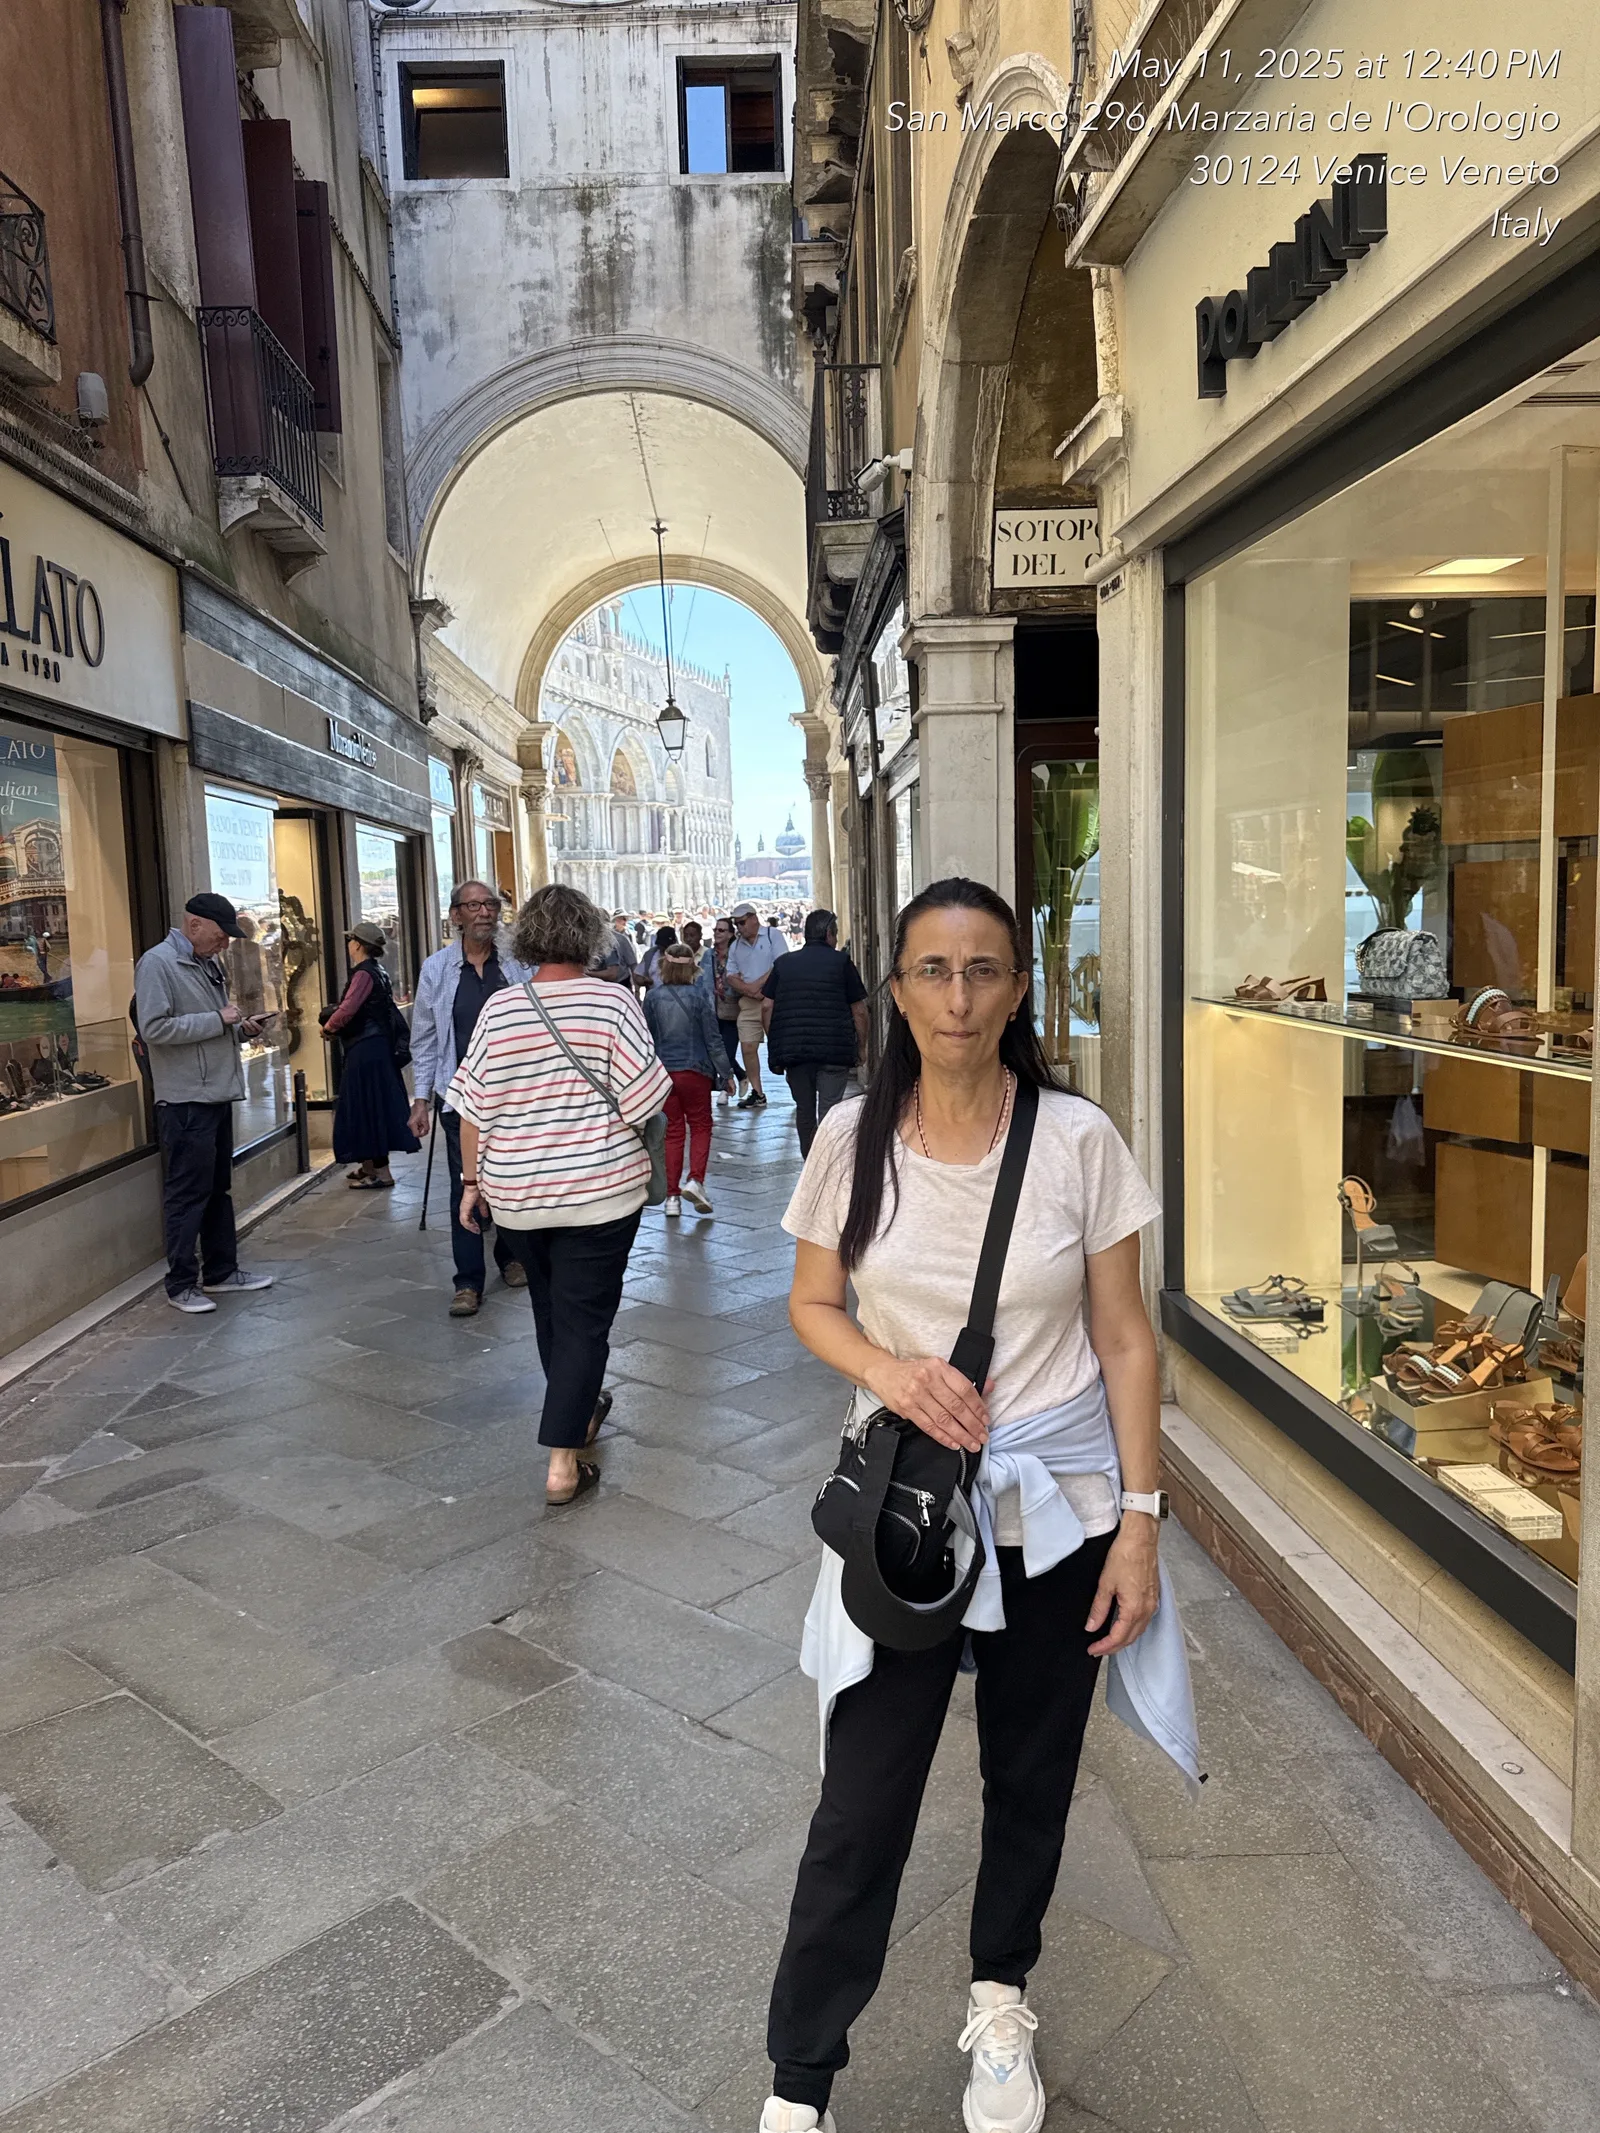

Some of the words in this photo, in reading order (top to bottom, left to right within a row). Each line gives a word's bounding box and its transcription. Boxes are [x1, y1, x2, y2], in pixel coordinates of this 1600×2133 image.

[1012, 553, 1066, 576] DEL
[0, 535, 105, 668] LATO
[21, 649, 61, 683] 1930
[0, 739, 46, 760] ATO
